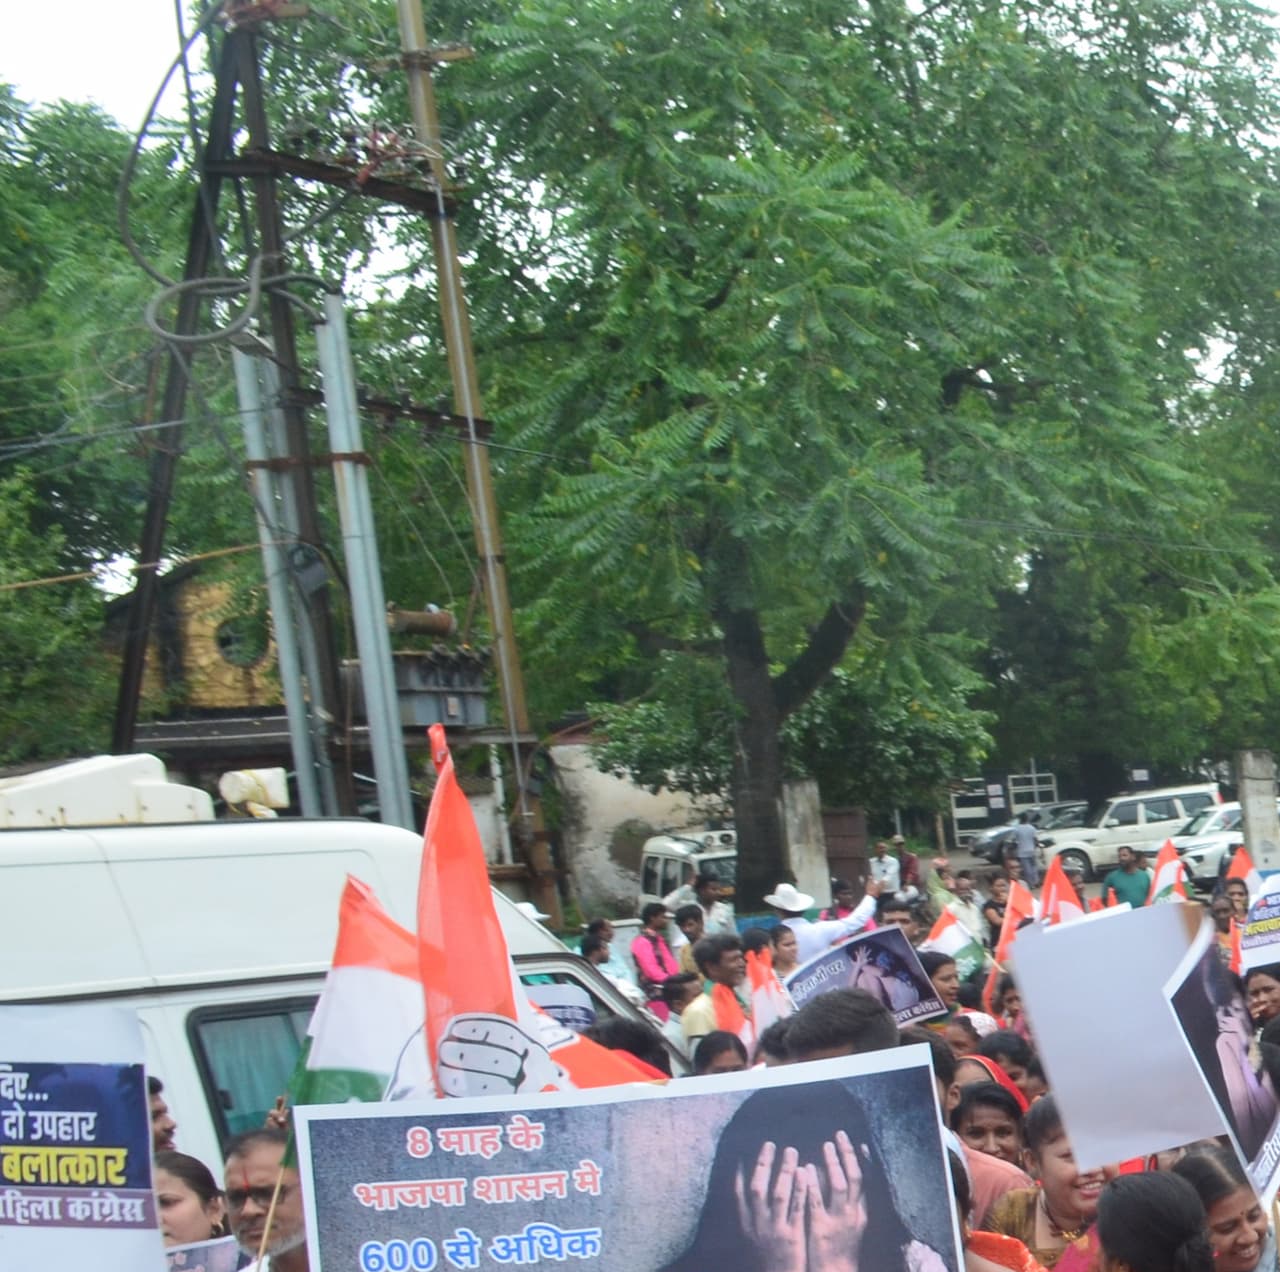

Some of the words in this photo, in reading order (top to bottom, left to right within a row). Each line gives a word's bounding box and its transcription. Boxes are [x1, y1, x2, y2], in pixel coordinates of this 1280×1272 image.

[1, 1101, 26, 1140] दो
[28, 1110, 98, 1141] उपहार
[408, 1127, 432, 1158] 8
[438, 1123, 501, 1159] माह
[508, 1115, 545, 1151] के
[1, 1145, 128, 1186] बलात्कार
[355, 1178, 467, 1210] भाजपा
[473, 1169, 569, 1203] शासन
[574, 1159, 602, 1195] मे
[67, 1191, 145, 1223] कांग्रेस
[444, 1228, 481, 1268] से
[490, 1222, 602, 1263] अधिक
